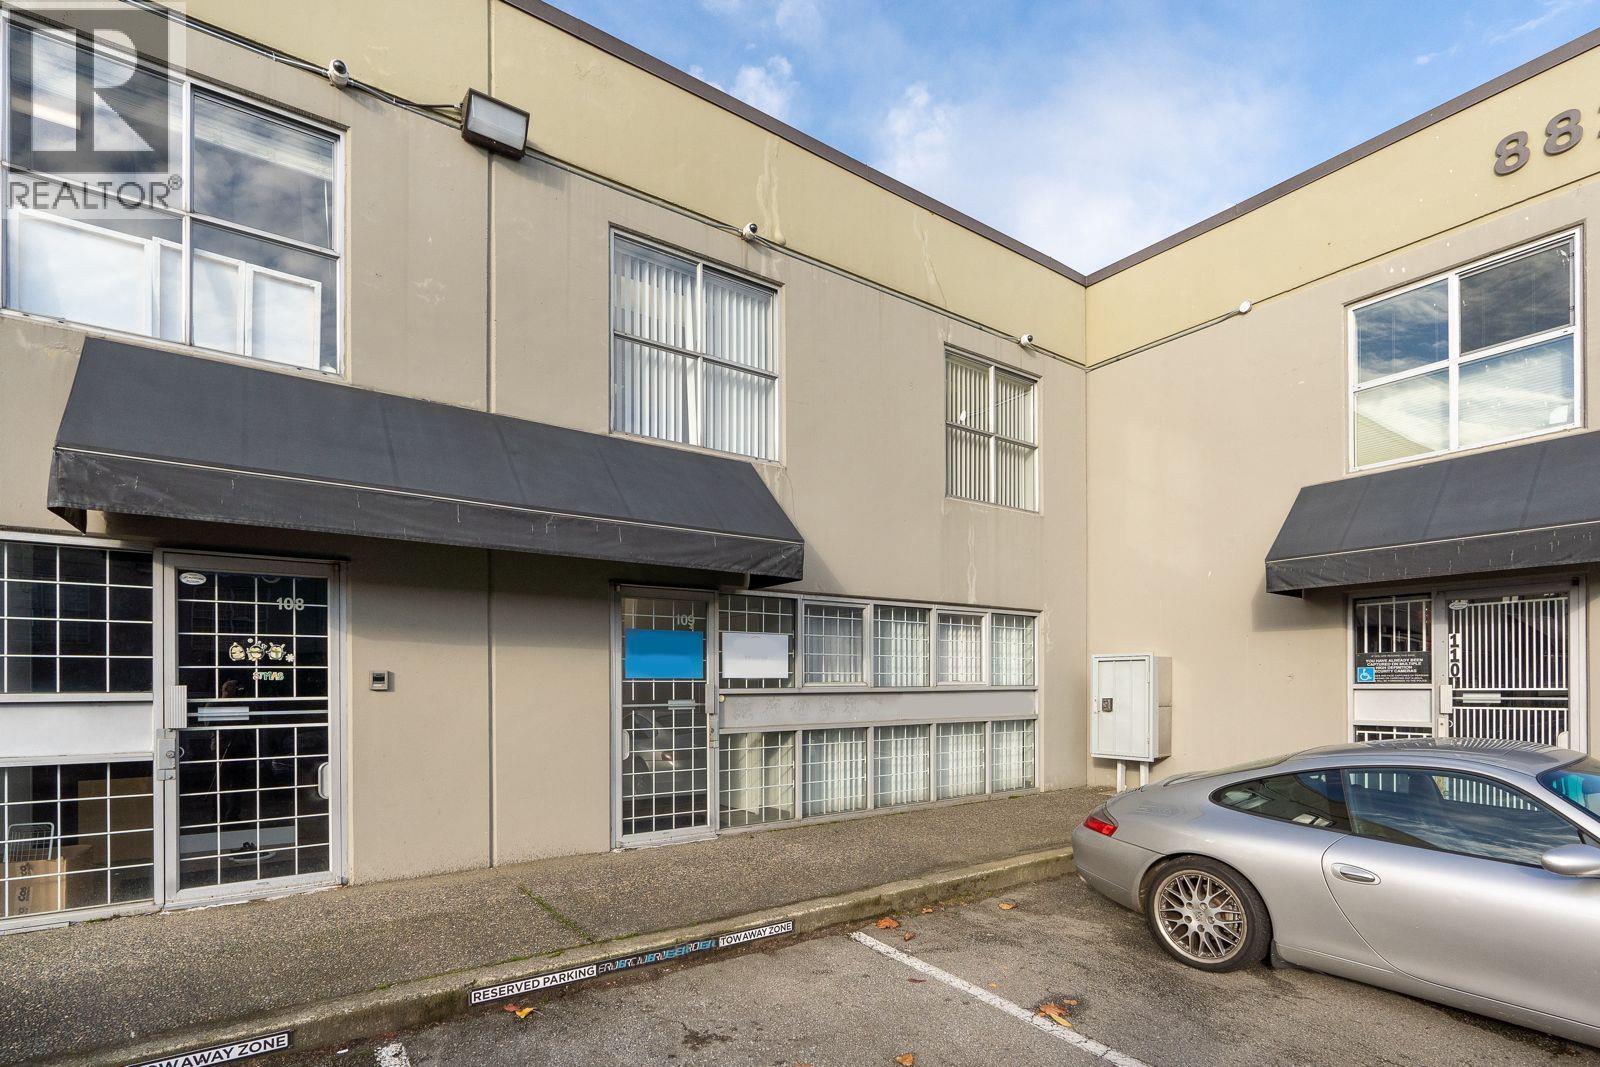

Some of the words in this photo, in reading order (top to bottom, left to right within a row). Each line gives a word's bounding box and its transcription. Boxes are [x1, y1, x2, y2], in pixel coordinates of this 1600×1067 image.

[1494, 108, 1600, 176] 88
[276, 597, 305, 611] 108
[1450, 633, 1460, 677] 110
[769, 923, 792, 934] ZONE
[473, 979, 540, 1002] RESERVED
[543, 966, 595, 987] PARKING
[238, 1035, 286, 1057] ZONE
